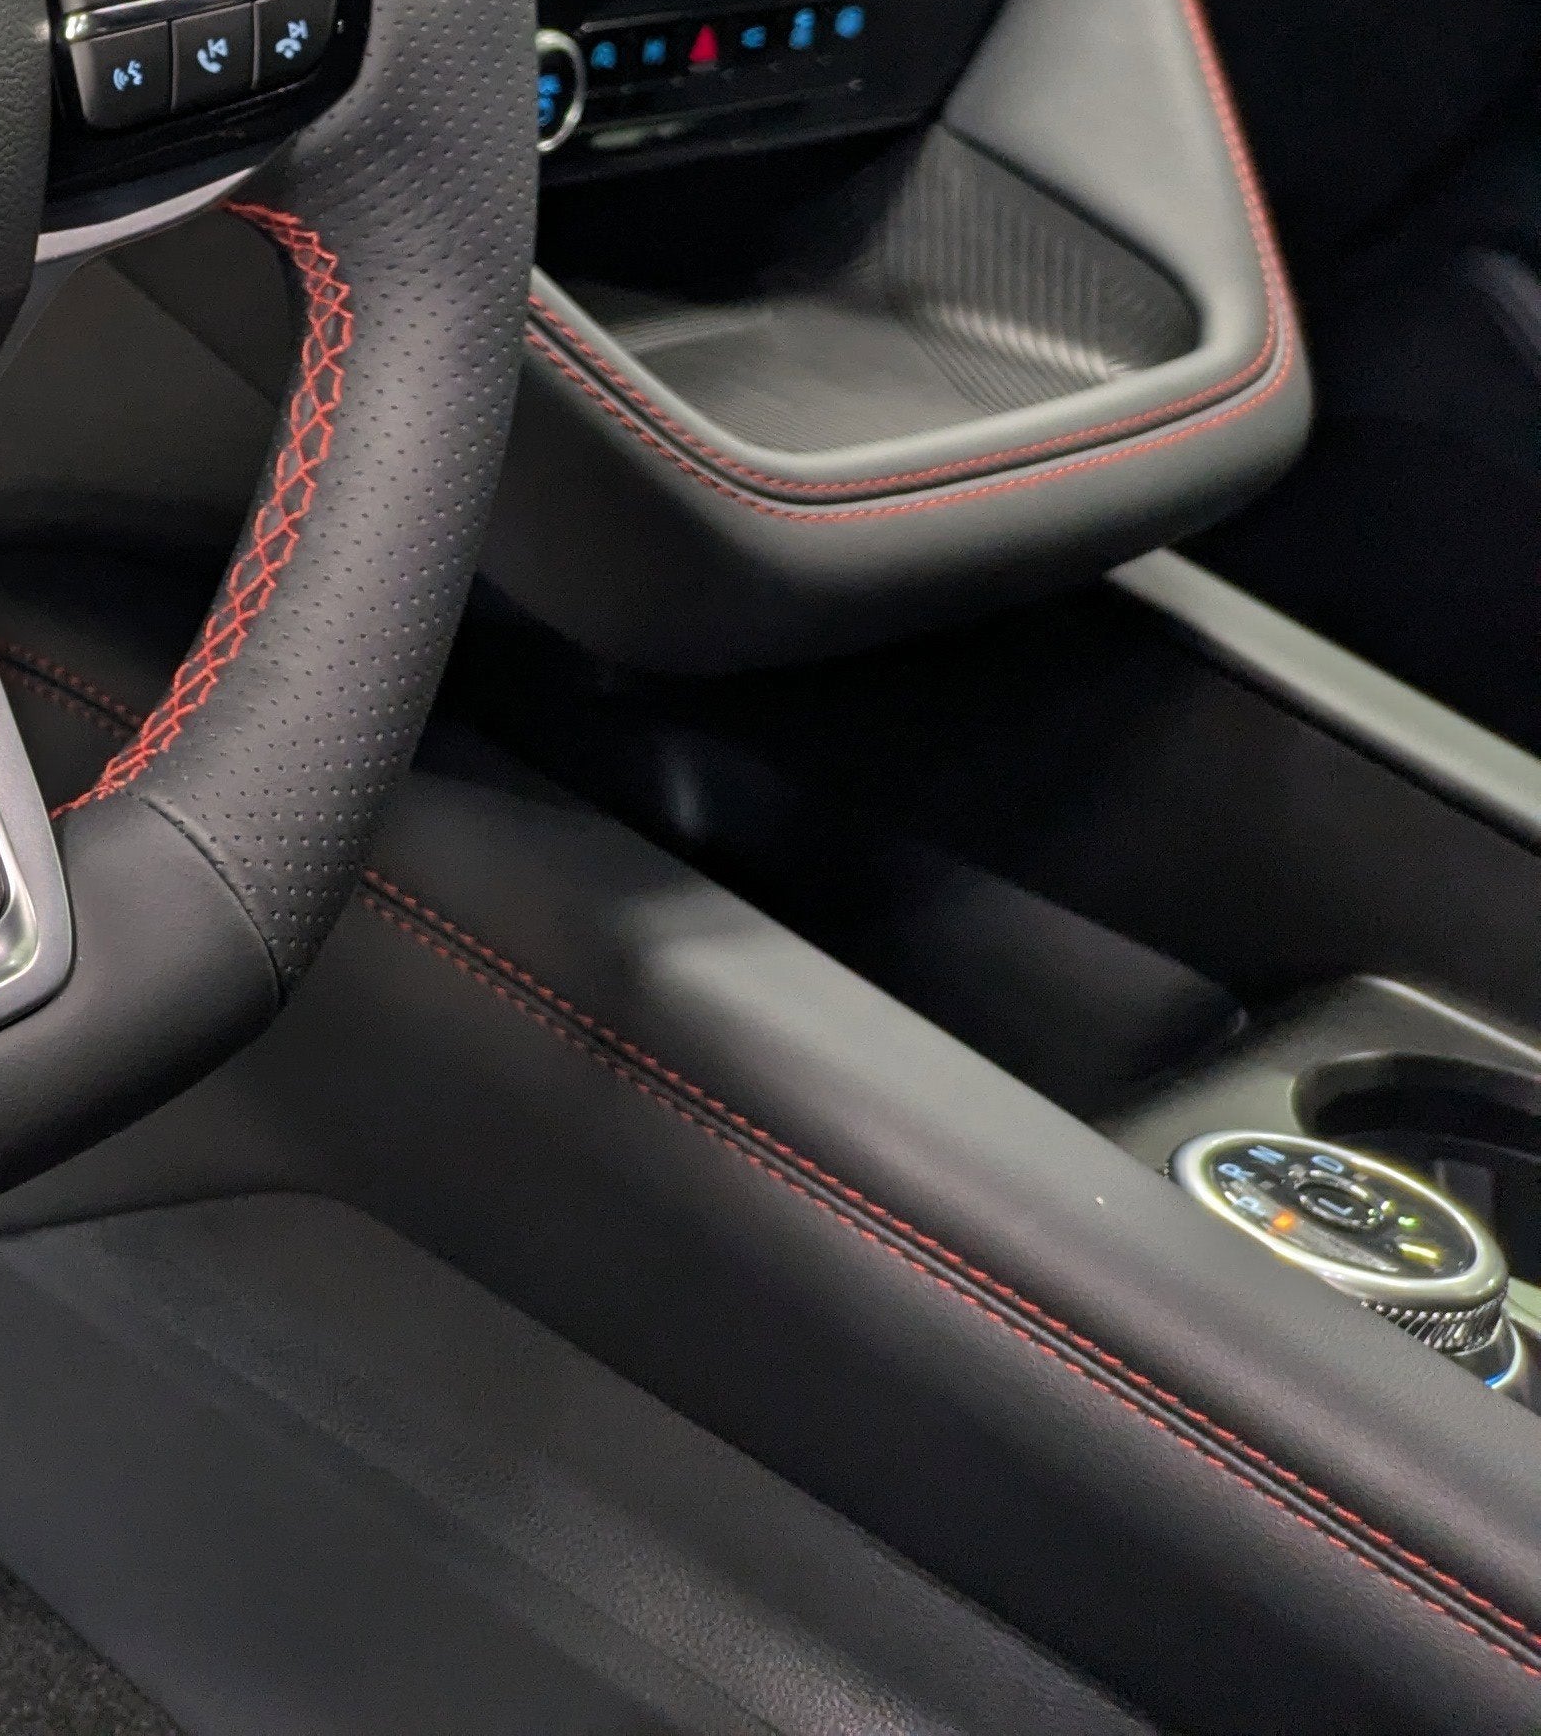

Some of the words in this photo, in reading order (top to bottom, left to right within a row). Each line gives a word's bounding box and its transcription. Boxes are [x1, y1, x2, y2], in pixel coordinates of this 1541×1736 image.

[1246, 1145, 1289, 1164] N
[1218, 1162, 1255, 1182] R
[1232, 1194, 1267, 1217] P
[1318, 1196, 1353, 1217] L
